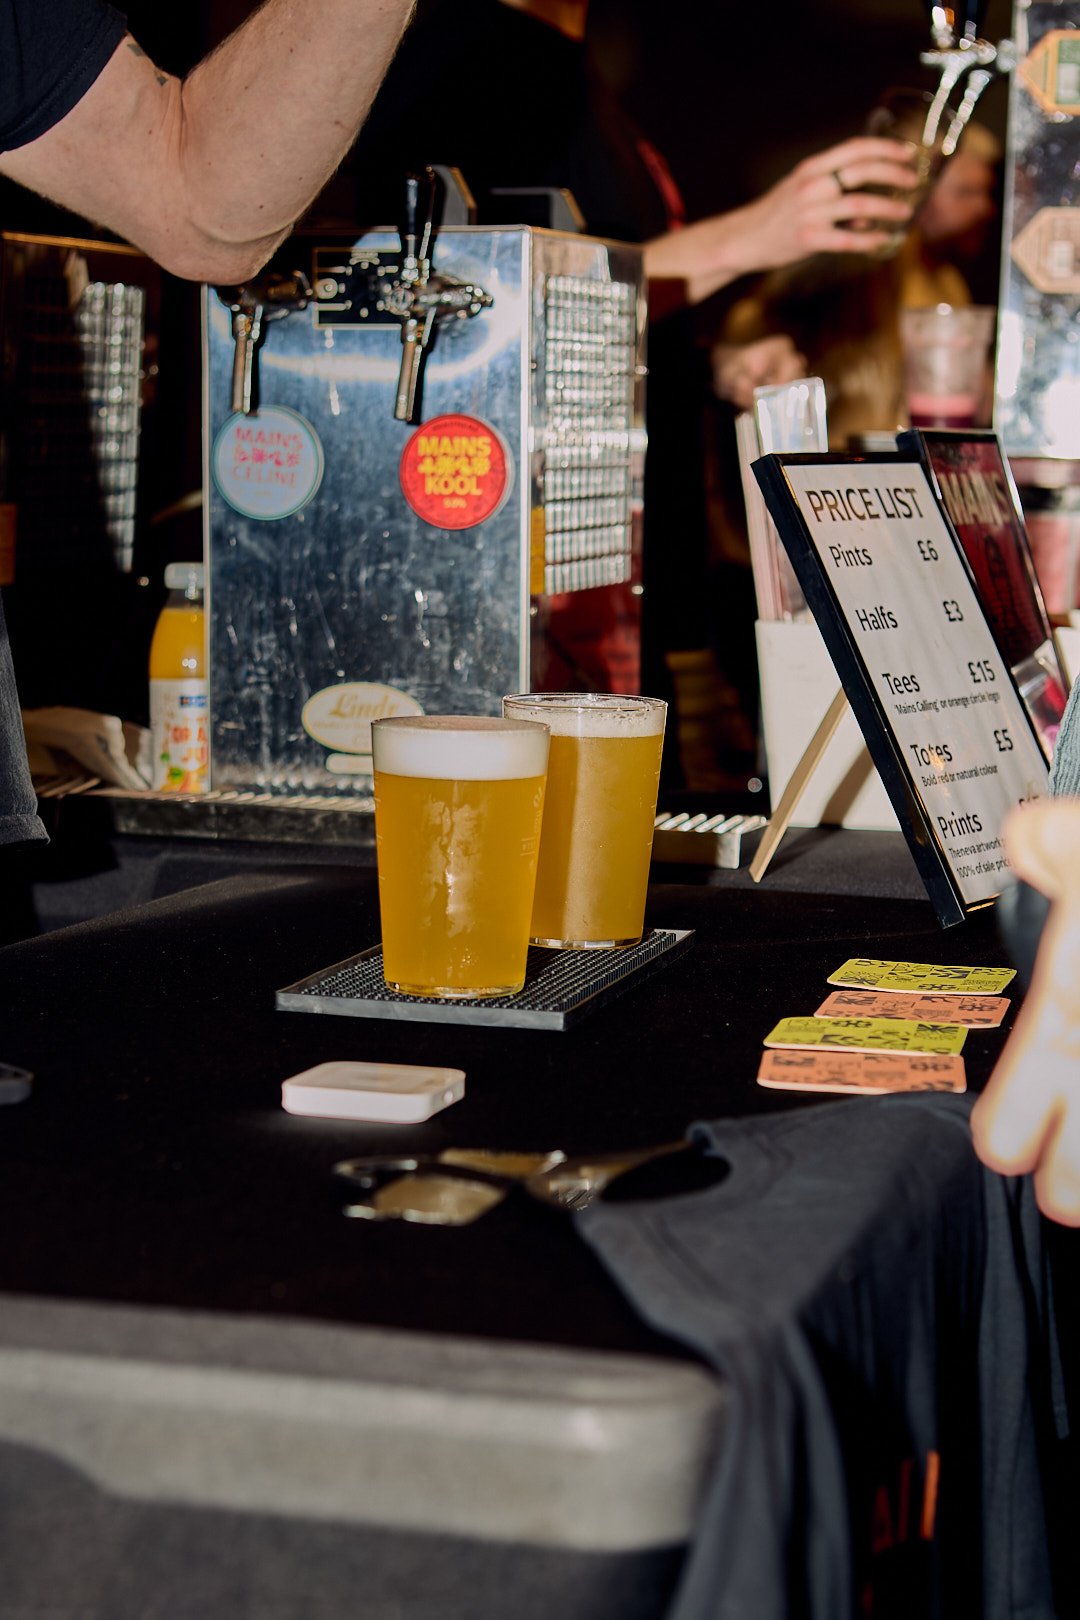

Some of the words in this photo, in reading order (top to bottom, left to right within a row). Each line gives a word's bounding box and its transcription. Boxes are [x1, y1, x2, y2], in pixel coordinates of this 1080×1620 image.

[417, 436, 491, 456] MAINS
[425, 476, 483, 496] KOOL
[938, 470, 1011, 527] MAINS
[805, 488, 880, 522] PRICE
[875, 488, 923, 519] LIST
[829, 543, 873, 568] Pints
[917, 540, 938, 562] £6
[855, 605, 898, 631] Halfs
[943, 600, 964, 622] £3
[882, 673, 920, 695] Tees
[968, 660, 996, 684] £15
[940, 700, 947, 708] or
[948, 697, 970, 708] orange
[970, 694, 986, 703] circle
[910, 744, 953, 767] Totes
[993, 729, 1014, 752] £5
[921, 774, 937, 787] Bold
[938, 772, 949, 784] red
[956, 766, 978, 780] natural
[979, 764, 998, 776] colour
[937, 811, 983, 839] Prints
[977, 837, 1003, 851] artwork
[956, 864, 976, 878] 100%
[976, 862, 984, 874] of
[984, 861, 996, 873] sale
